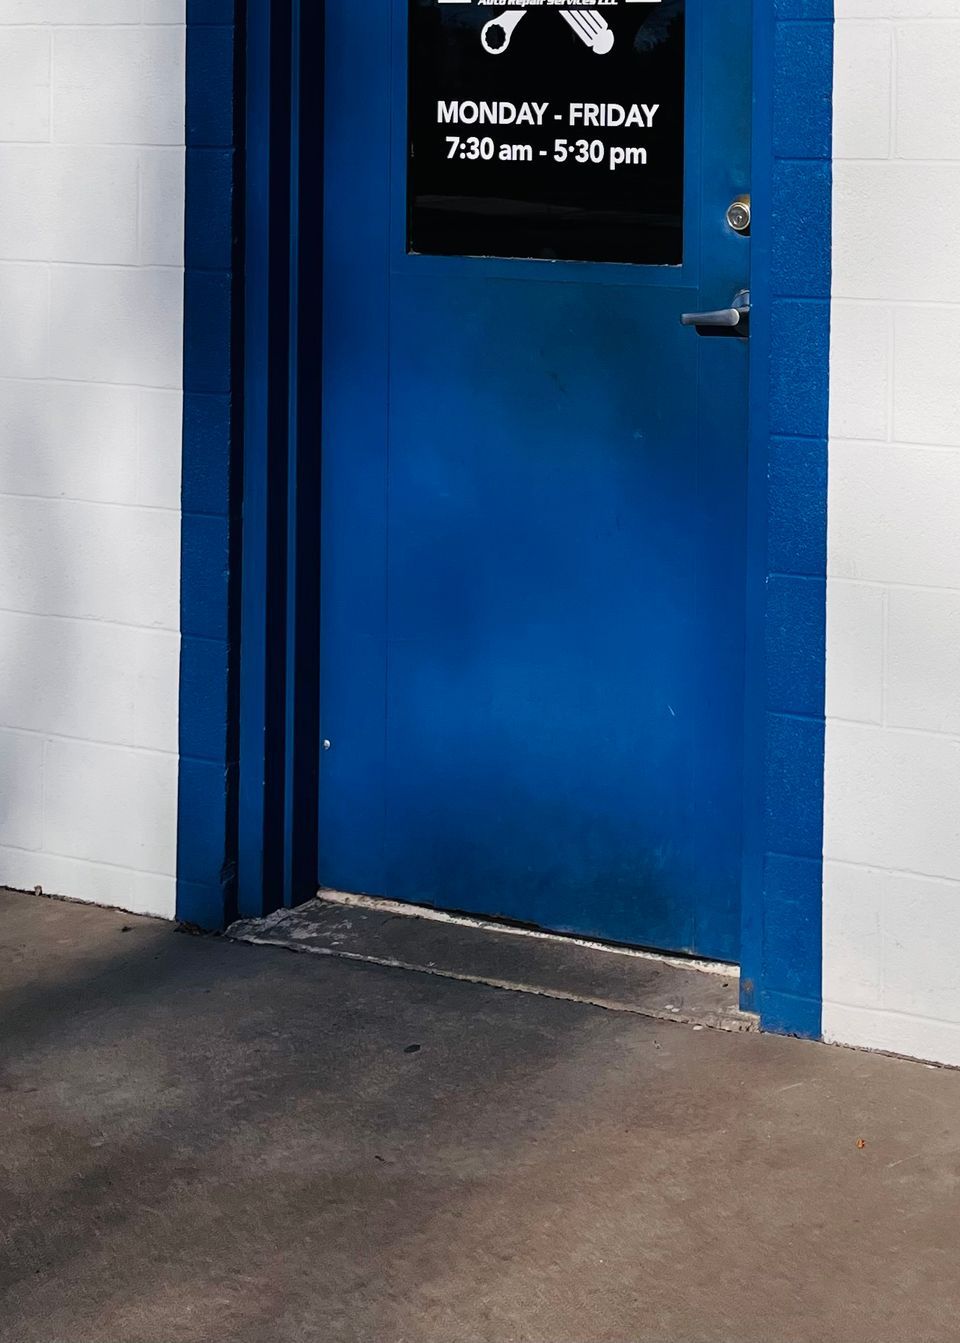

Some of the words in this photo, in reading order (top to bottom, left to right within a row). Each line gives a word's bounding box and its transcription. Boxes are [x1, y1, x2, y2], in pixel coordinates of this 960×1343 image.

[437, 100, 550, 126] MONDAY
[568, 102, 660, 128] FRIDAY
[445, 136, 495, 160] 7:30
[498, 143, 533, 162] am
[609, 146, 648, 171] pm
